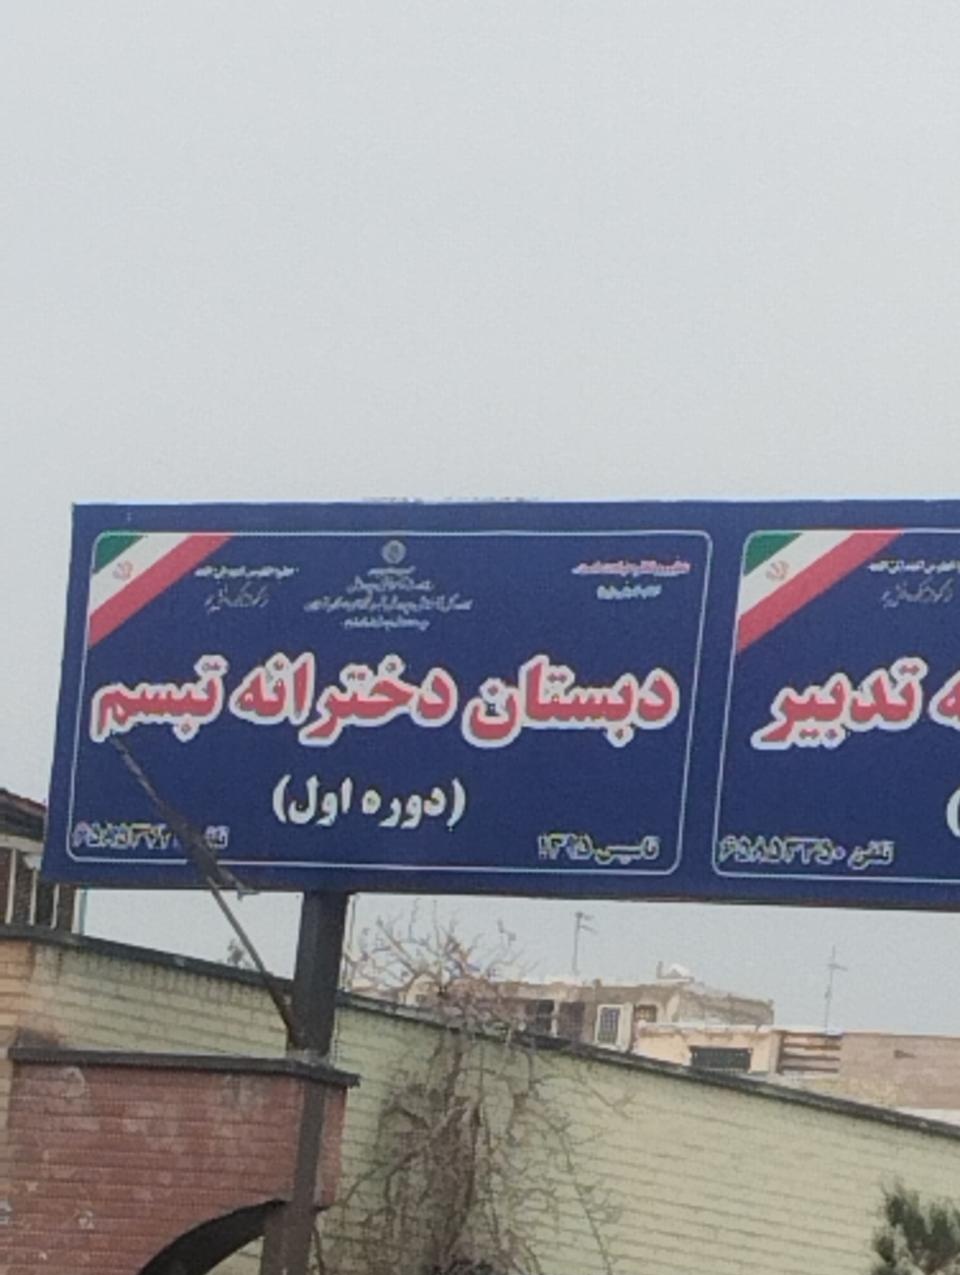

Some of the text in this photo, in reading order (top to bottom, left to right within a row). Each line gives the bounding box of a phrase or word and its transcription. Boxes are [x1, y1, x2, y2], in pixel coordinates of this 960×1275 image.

[90, 652, 680, 749] دبستان دخترانه تبسم
[751, 656, 928, 751] تدبیر
[272, 774, 466, 829] (دوره اول)
